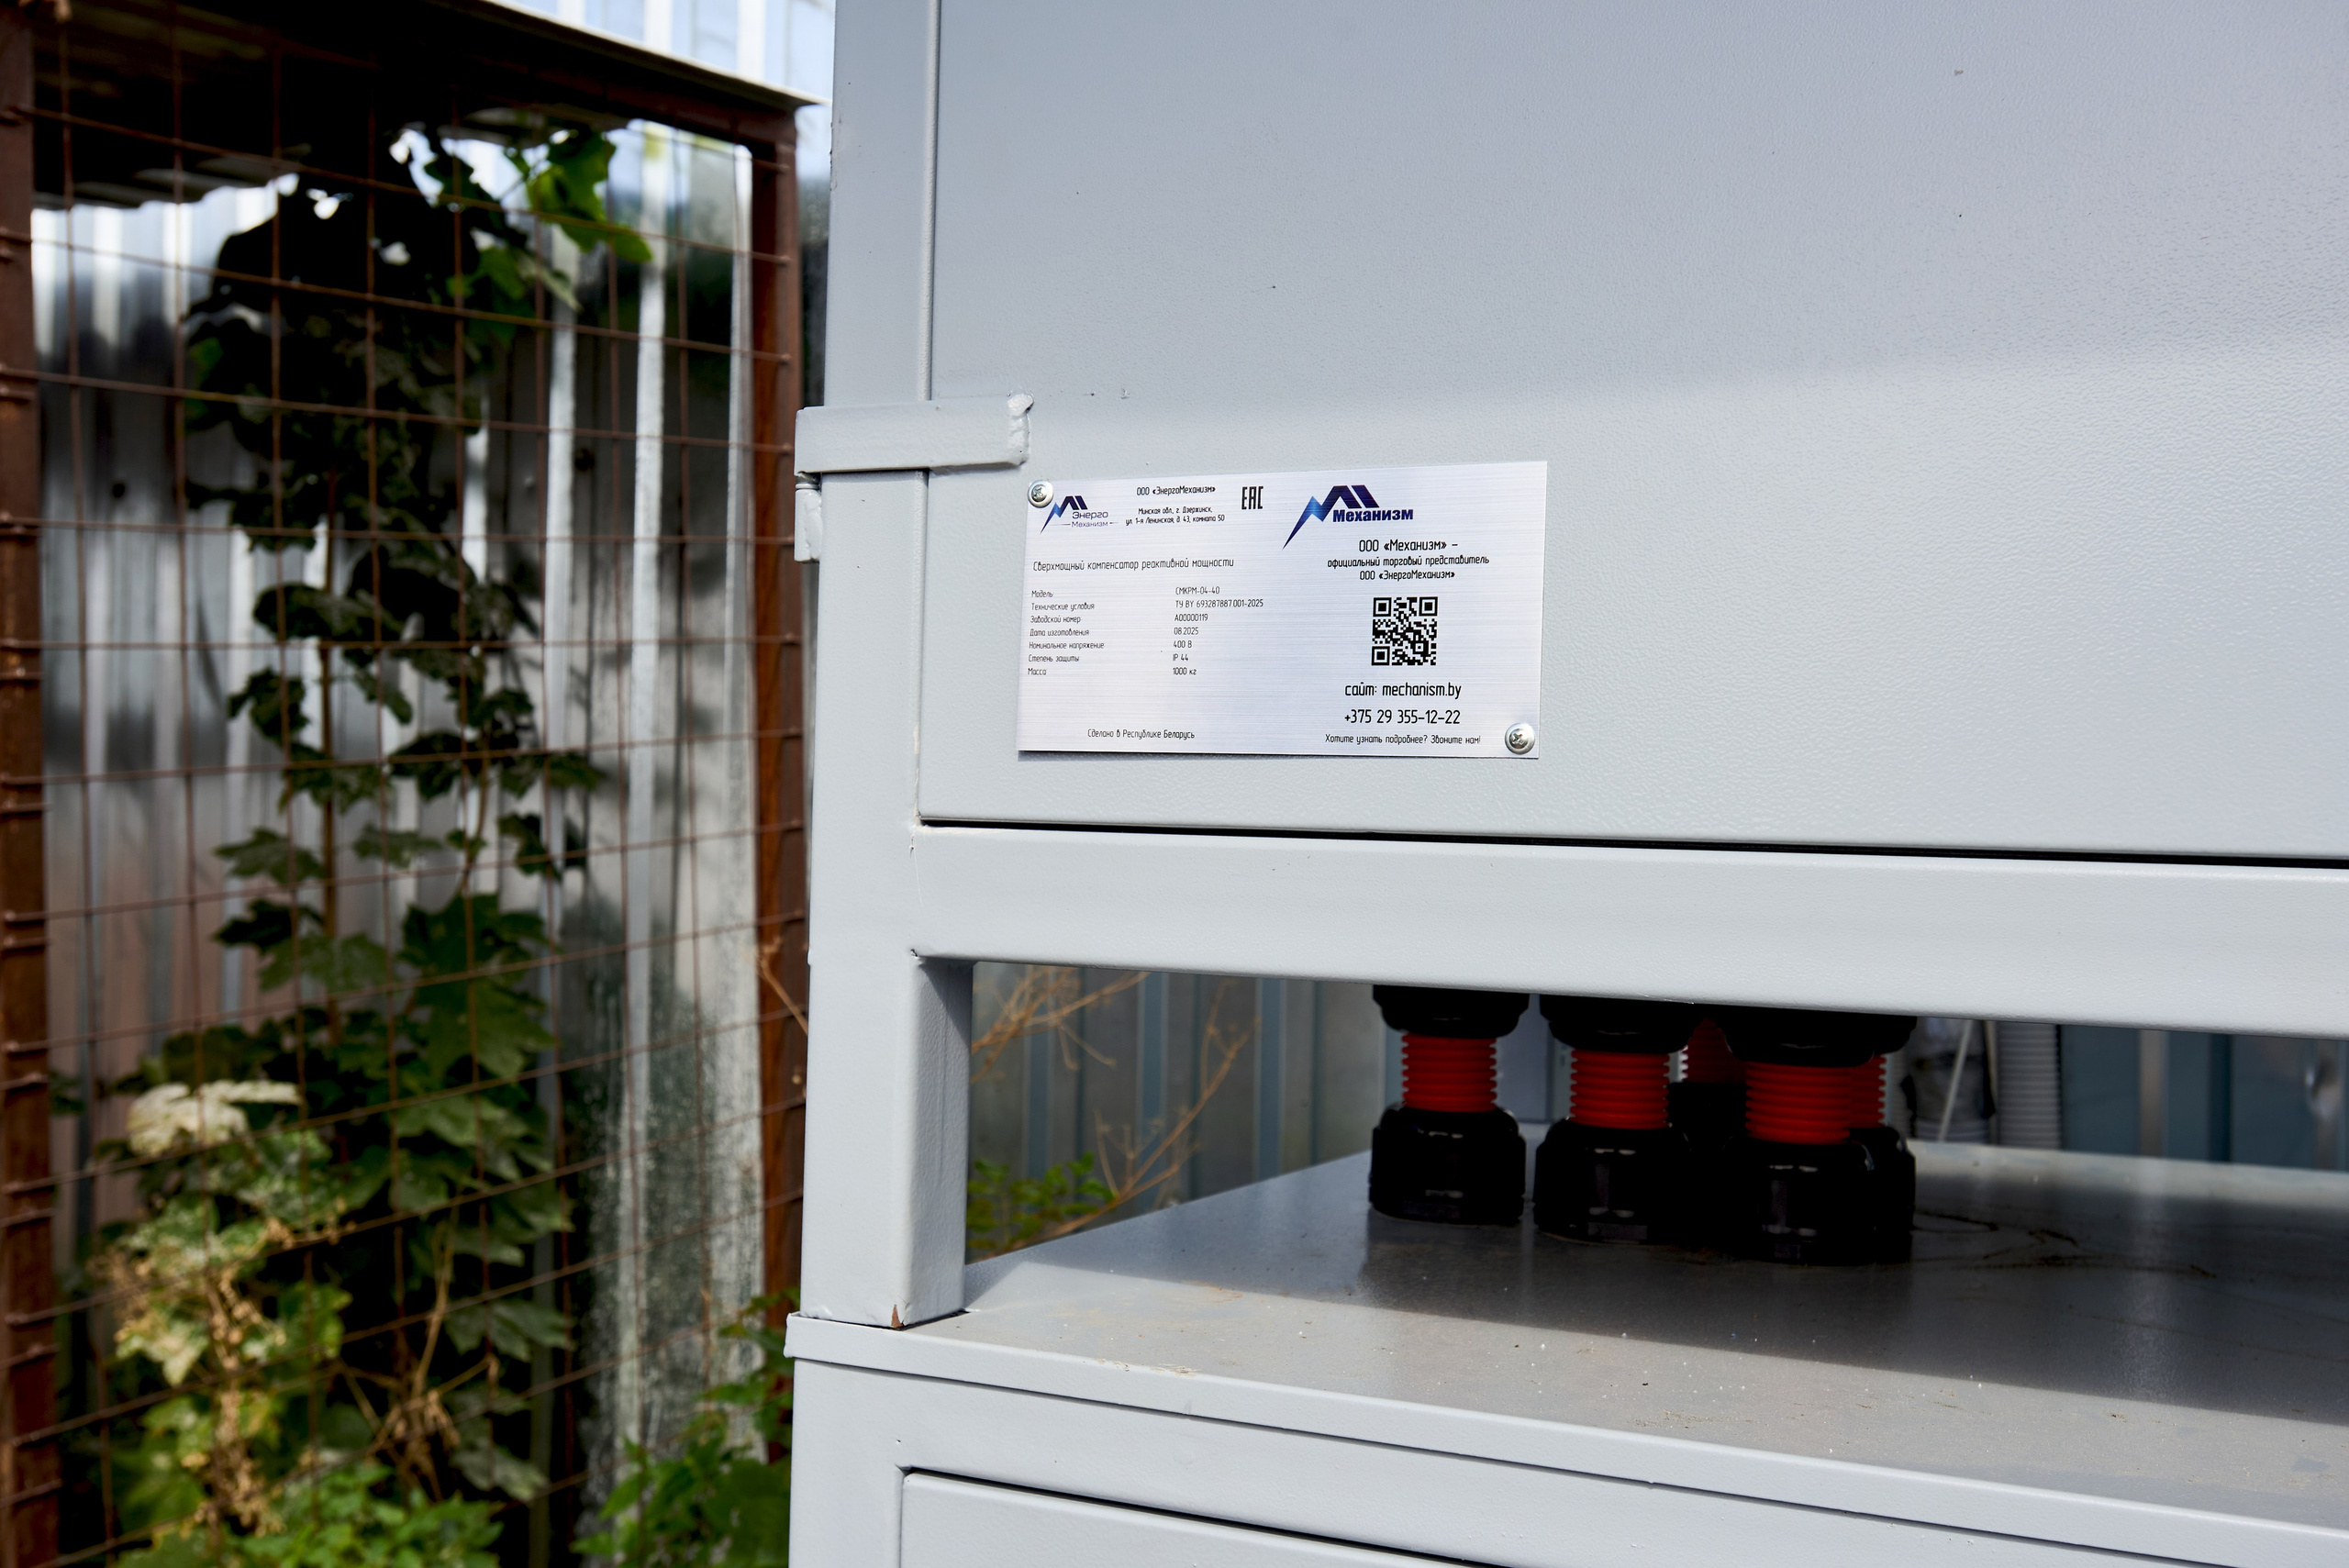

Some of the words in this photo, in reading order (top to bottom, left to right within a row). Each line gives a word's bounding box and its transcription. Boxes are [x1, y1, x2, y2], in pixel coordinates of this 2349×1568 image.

[1136, 486, 1150, 495] ООО
[1152, 485, 1216, 496] «ЭнергоМеханизм»
[1072, 511, 1108, 520] Энерго
[1218, 514, 1226, 522] 50
[1333, 509, 1414, 523] Механизм
[1359, 539, 1379, 552] ООО
[1384, 539, 1447, 552] «Механизм»
[1033, 561, 1085, 572] Сверхмощный
[1087, 560, 1139, 571] компенсатор
[1141, 558, 1189, 570] реактивной
[1192, 558, 1234, 569] мощности
[1327, 556, 1380, 569] официальный
[1383, 555, 1422, 568] торговый
[1425, 554, 1489, 567] представитель
[1359, 570, 1375, 580] ООО
[1379, 570, 1455, 582] «ЭнергоМеханизм»
[1071, 602, 1095, 612] условия
[1175, 600, 1184, 608] ТУ
[1030, 615, 1061, 623] Заводской
[1063, 616, 1081, 624] номер
[1048, 628, 1089, 636] изготовления
[1069, 642, 1105, 651] напряжение
[1173, 640, 1186, 649] 400
[1029, 653, 1053, 662] Степень
[1173, 667, 1187, 676] 1000
[1344, 682, 1377, 696] сайт:
[1382, 682, 1462, 700] mechanism.by
[1344, 709, 1372, 724] +375
[1376, 709, 1393, 724] 29
[1397, 709, 1461, 724] 355-12-22
[1087, 728, 1114, 739] Сделано
[1116, 728, 1120, 738] в
[1122, 729, 1162, 740] Республике
[1163, 730, 1195, 740] Беларусь
[1325, 733, 1353, 743] Хотите
[1356, 735, 1383, 745] узнать
[1385, 734, 1428, 746] подробнее?
[1431, 734, 1462, 744] Звоните
[1465, 735, 1481, 744] нам!
